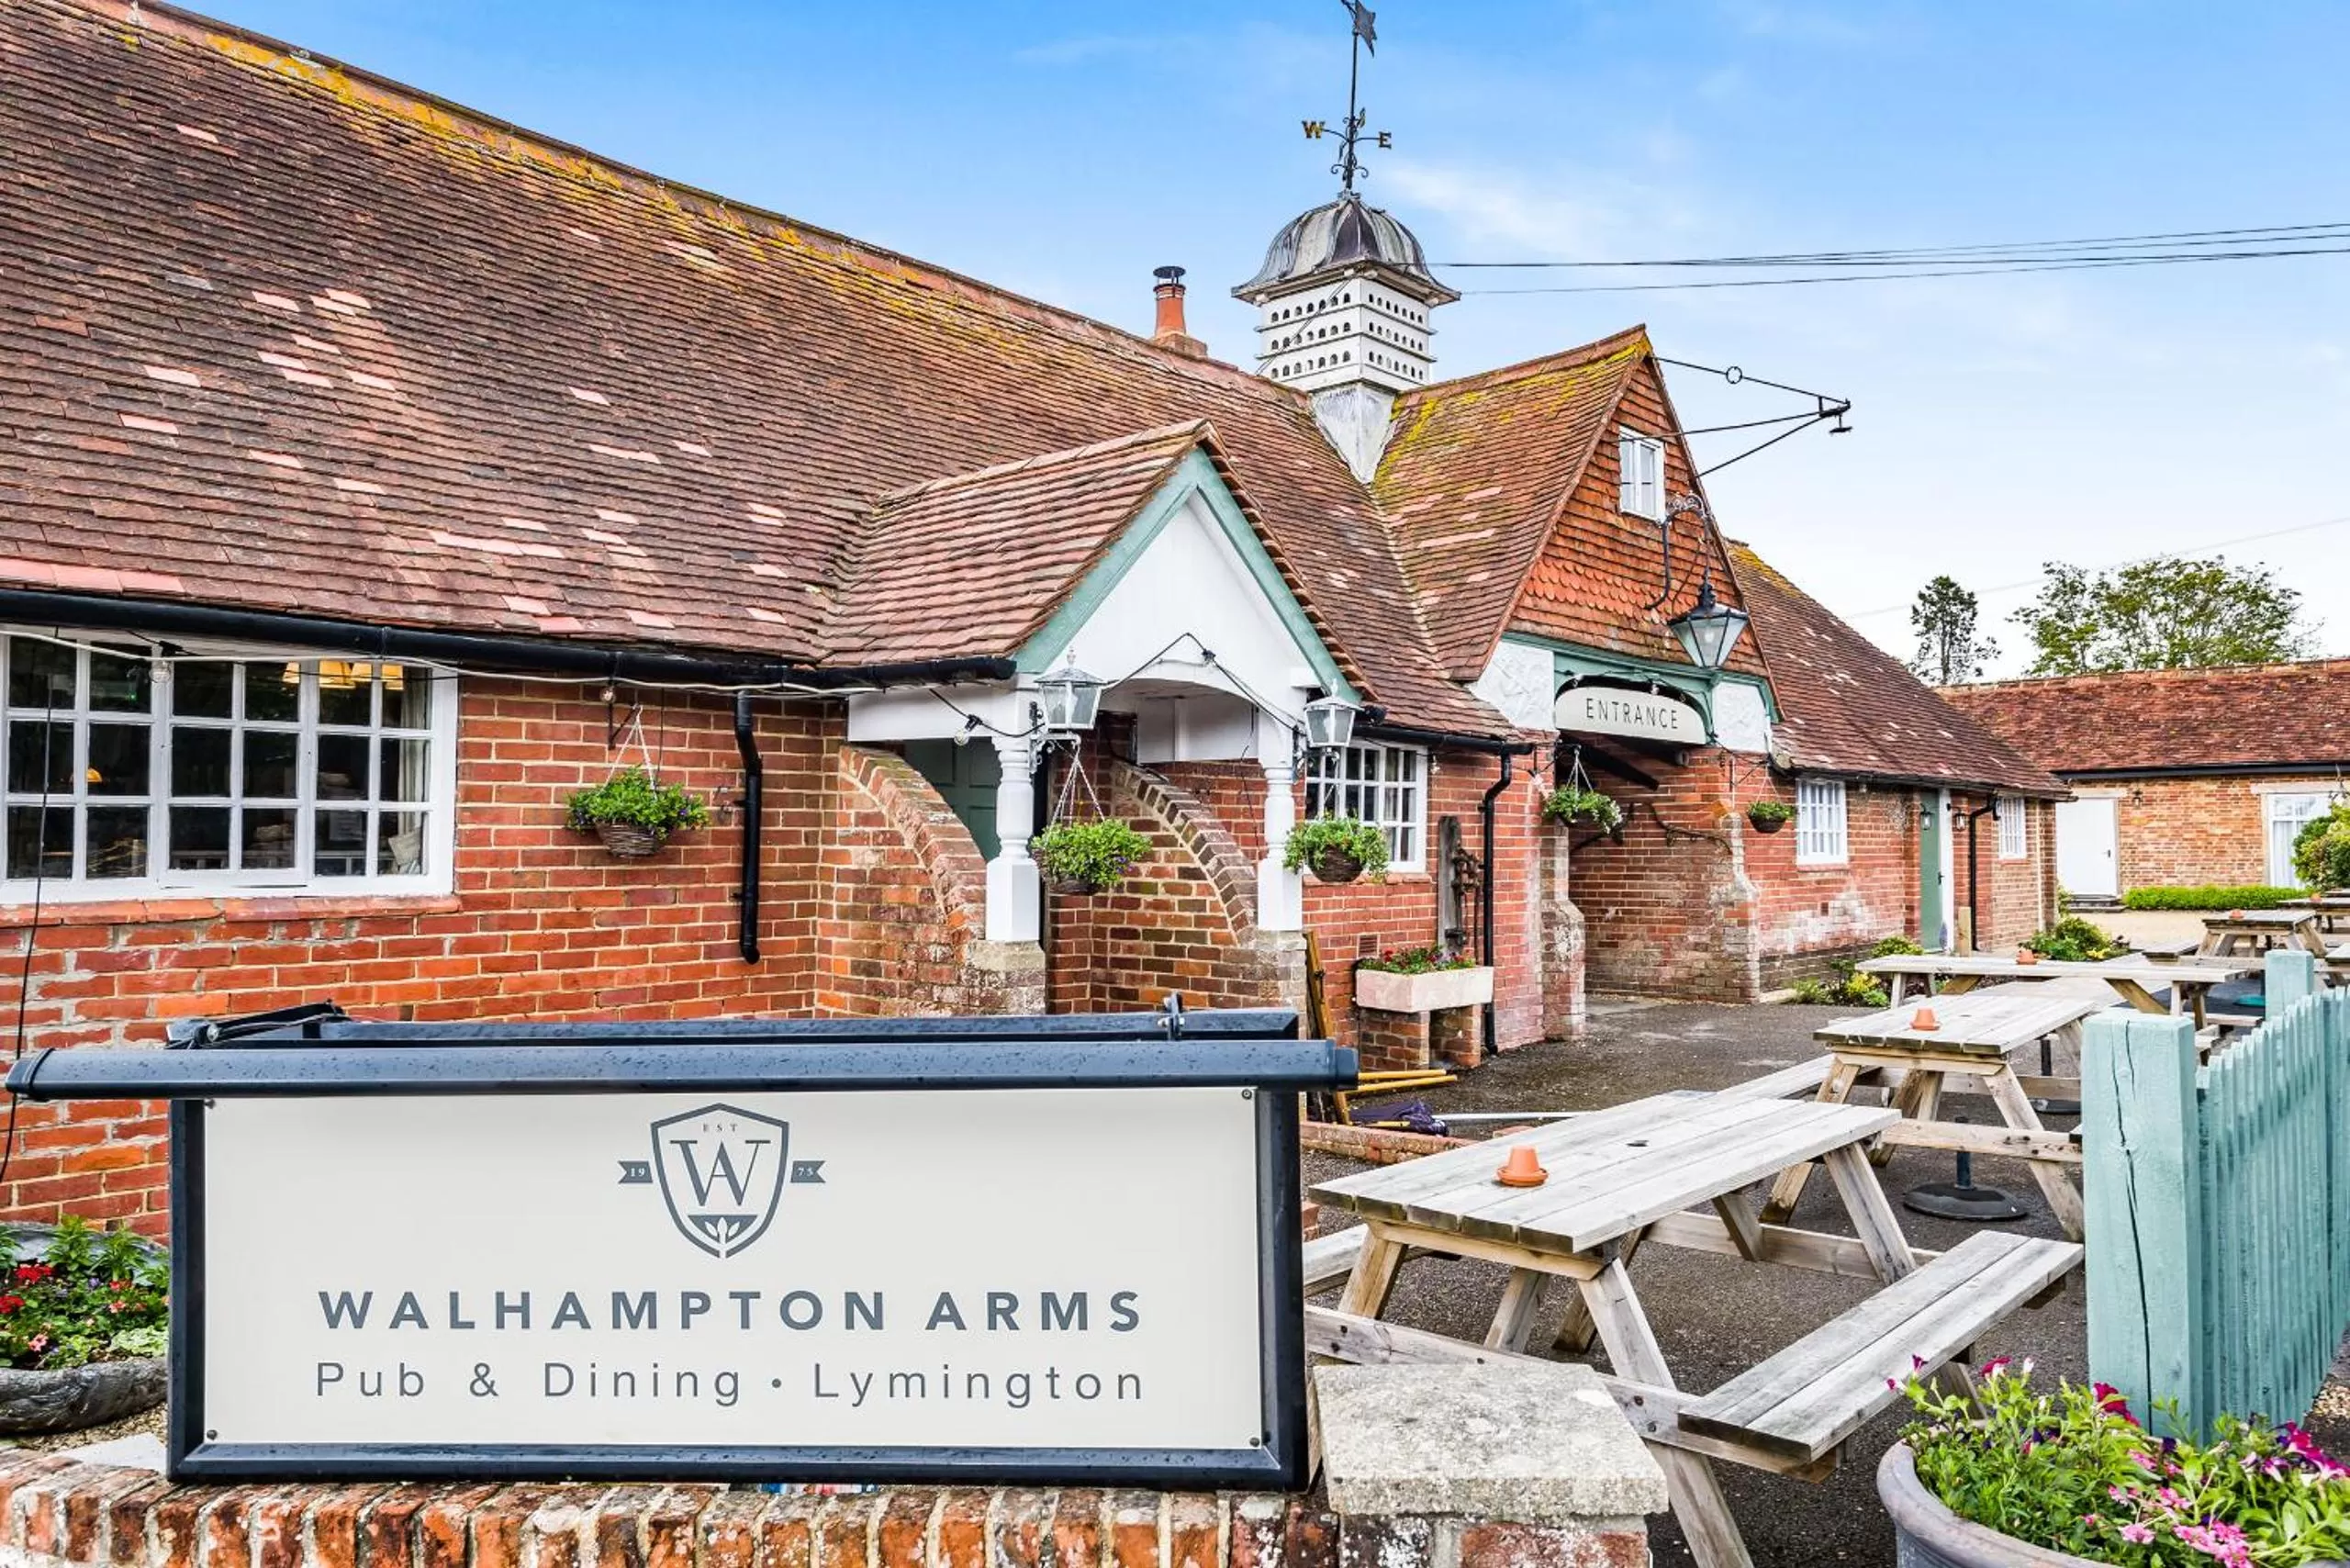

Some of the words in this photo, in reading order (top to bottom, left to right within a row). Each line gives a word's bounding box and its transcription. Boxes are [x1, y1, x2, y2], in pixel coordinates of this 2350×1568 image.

[1302, 120, 1325, 139] W
[1379, 131, 1392, 149] E
[1585, 698, 1679, 730] ENTRANCE
[702, 1123, 738, 1133] EST
[630, 1167, 645, 1178] 19
[319, 1291, 883, 1331] WALHAMPTON
[925, 1291, 1140, 1332] ARMS
[317, 1361, 424, 1397] Pub
[469, 1361, 499, 1398] &
[544, 1361, 739, 1407] Dining
[814, 1362, 1141, 1409] Lymington
